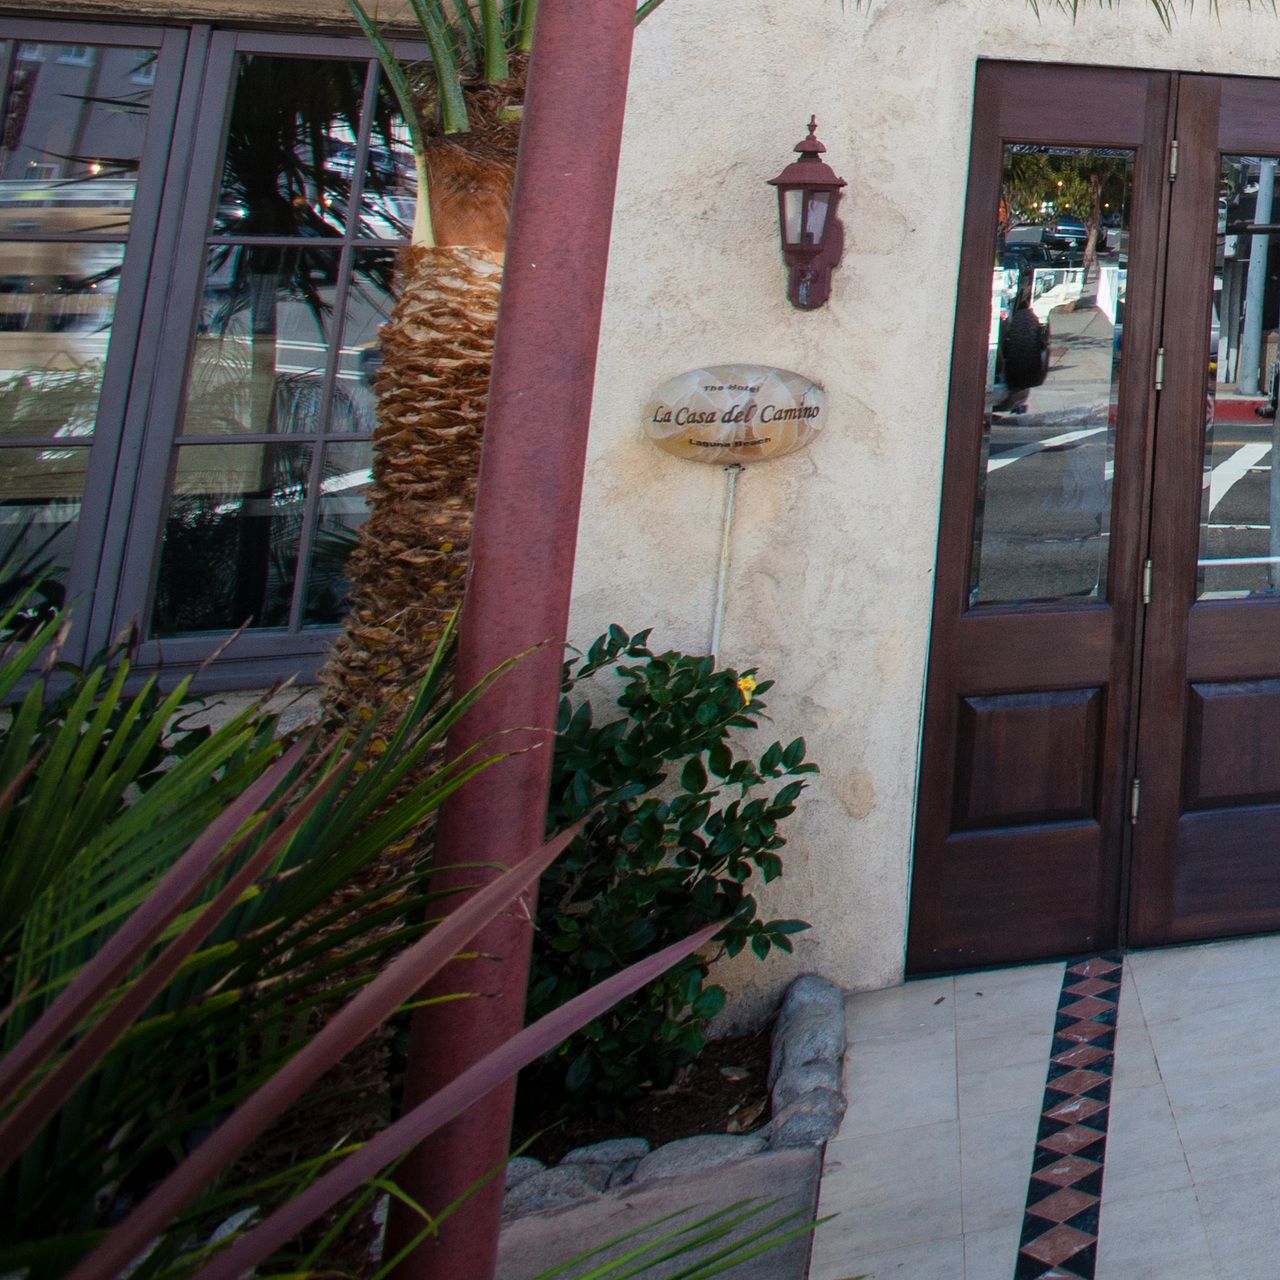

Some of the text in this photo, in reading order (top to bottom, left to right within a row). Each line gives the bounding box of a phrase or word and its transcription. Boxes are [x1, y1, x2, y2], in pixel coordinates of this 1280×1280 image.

[652, 402, 820, 426] La Casa del Camino
[688, 437, 772, 448] Laguna Beach
